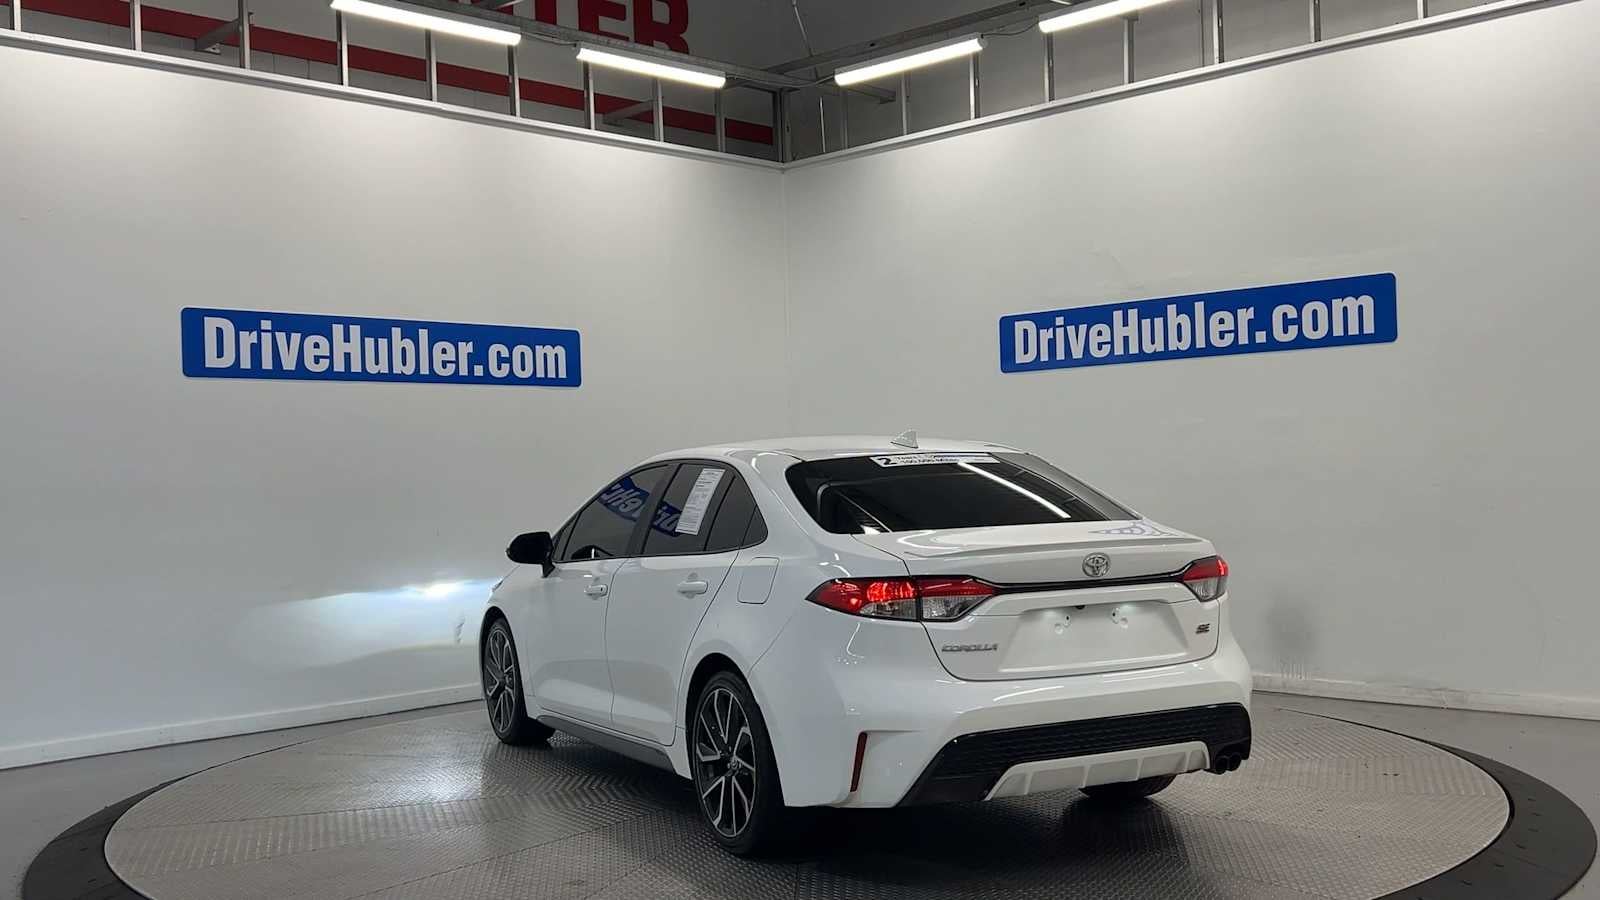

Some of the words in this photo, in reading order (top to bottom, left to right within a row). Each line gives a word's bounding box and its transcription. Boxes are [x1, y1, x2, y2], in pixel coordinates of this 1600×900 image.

[203, 317, 567, 379] DriveHubler.com
[1014, 295, 1375, 364] DriveHubler.com
[941, 643, 998, 653] COROLLA
